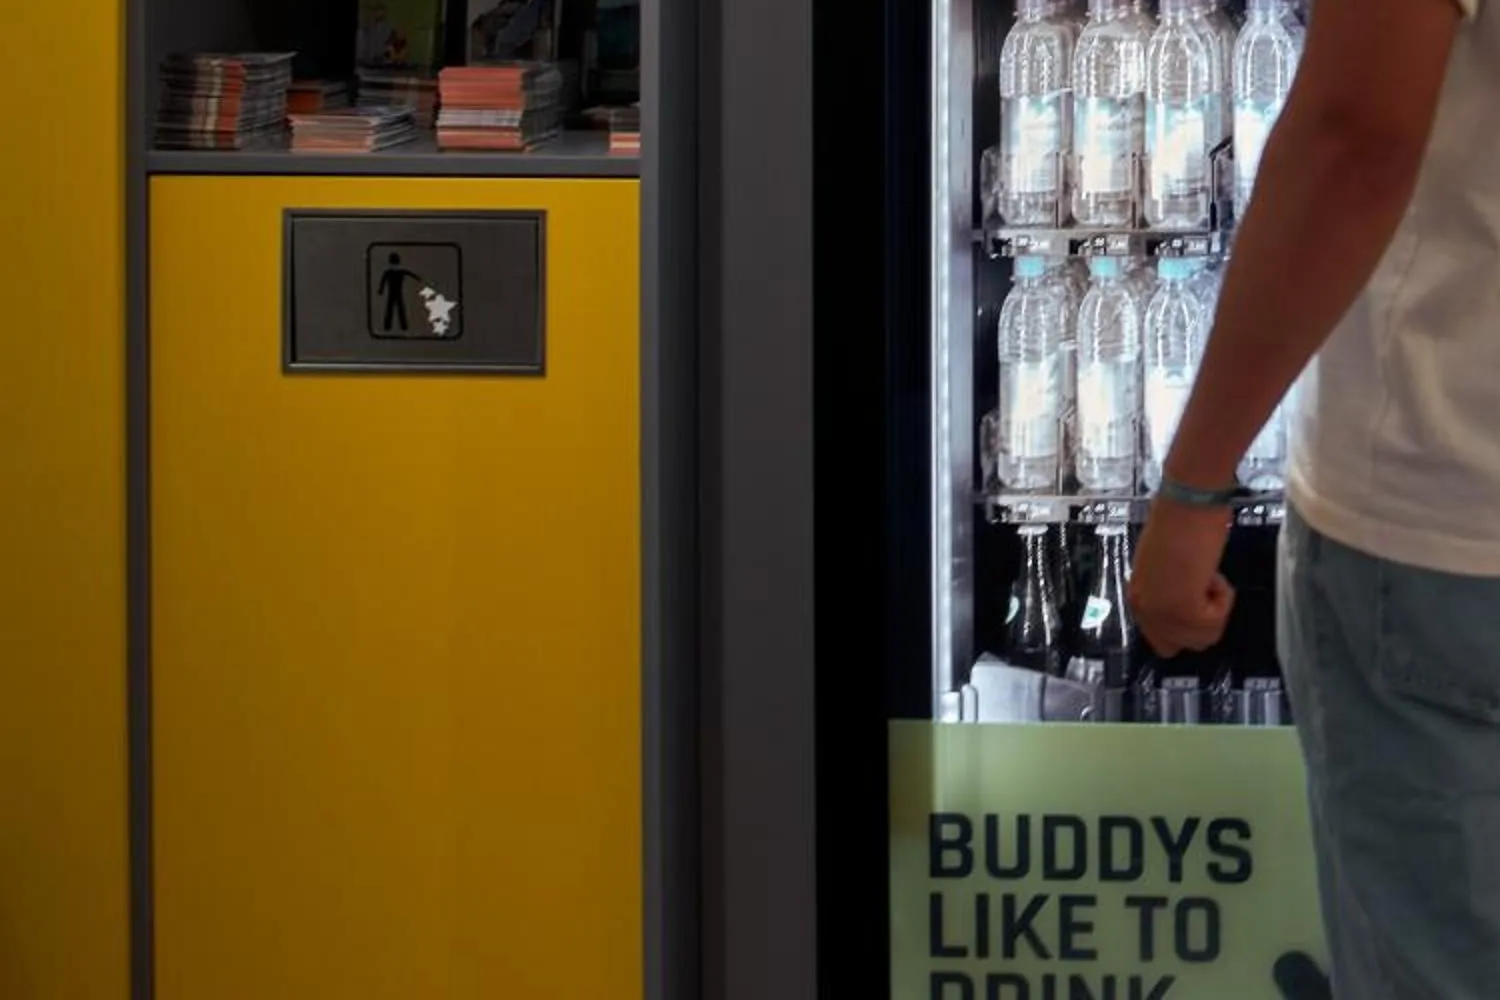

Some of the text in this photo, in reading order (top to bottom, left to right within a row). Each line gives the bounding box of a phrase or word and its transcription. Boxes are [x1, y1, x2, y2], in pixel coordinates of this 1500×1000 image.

[928, 811, 1254, 886] BUDDYS
[928, 891, 1222, 964] LIKE TO
